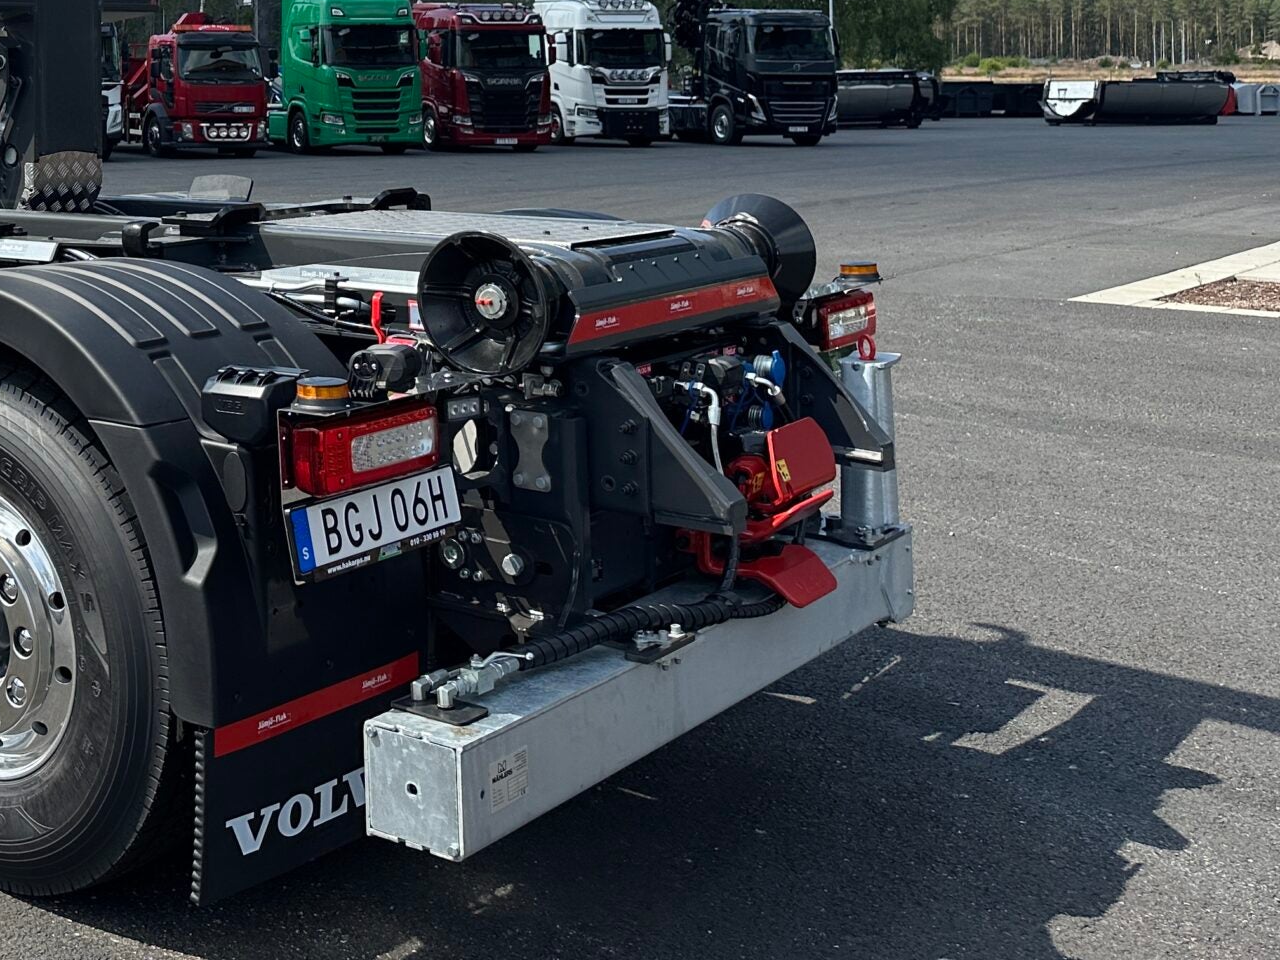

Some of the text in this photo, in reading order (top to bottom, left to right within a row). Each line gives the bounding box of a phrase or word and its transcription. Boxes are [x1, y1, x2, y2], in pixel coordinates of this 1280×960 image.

[486, 77, 522, 86] SCANIA
[46, 512, 87, 580] MAX
[302, 475, 449, 560] S BGJ 06H
[225, 765, 366, 856] VOLV
